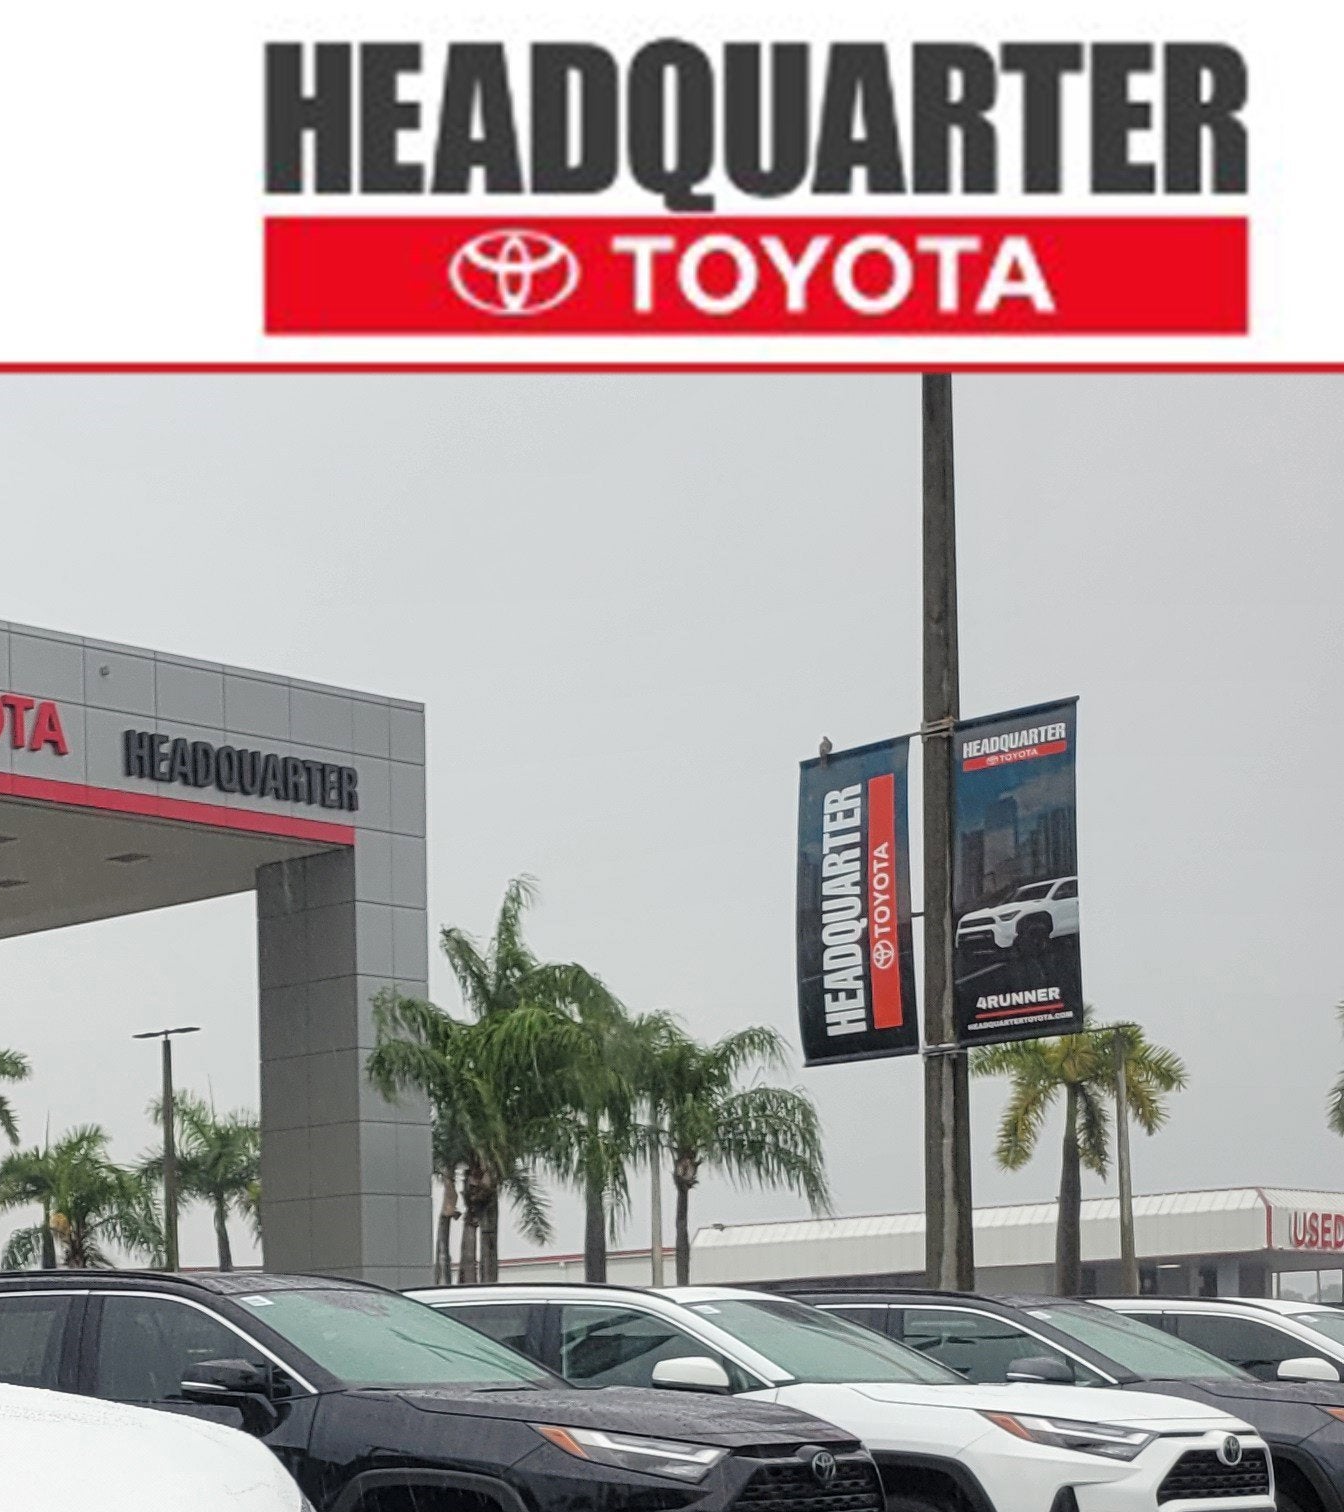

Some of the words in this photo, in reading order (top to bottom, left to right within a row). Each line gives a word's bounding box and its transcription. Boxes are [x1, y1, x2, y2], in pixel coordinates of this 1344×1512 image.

[963, 722, 1066, 758] HEADQUARTER
[999, 749, 1039, 763] TOYOTA
[123, 729, 359, 812] HEADQUARTER
[873, 841, 891, 938] TOYOTA
[822, 783, 868, 1037] HEADQUARTER
[976, 987, 1061, 1009] 4RUNNER
[1293, 1211, 1344, 1248] USED
